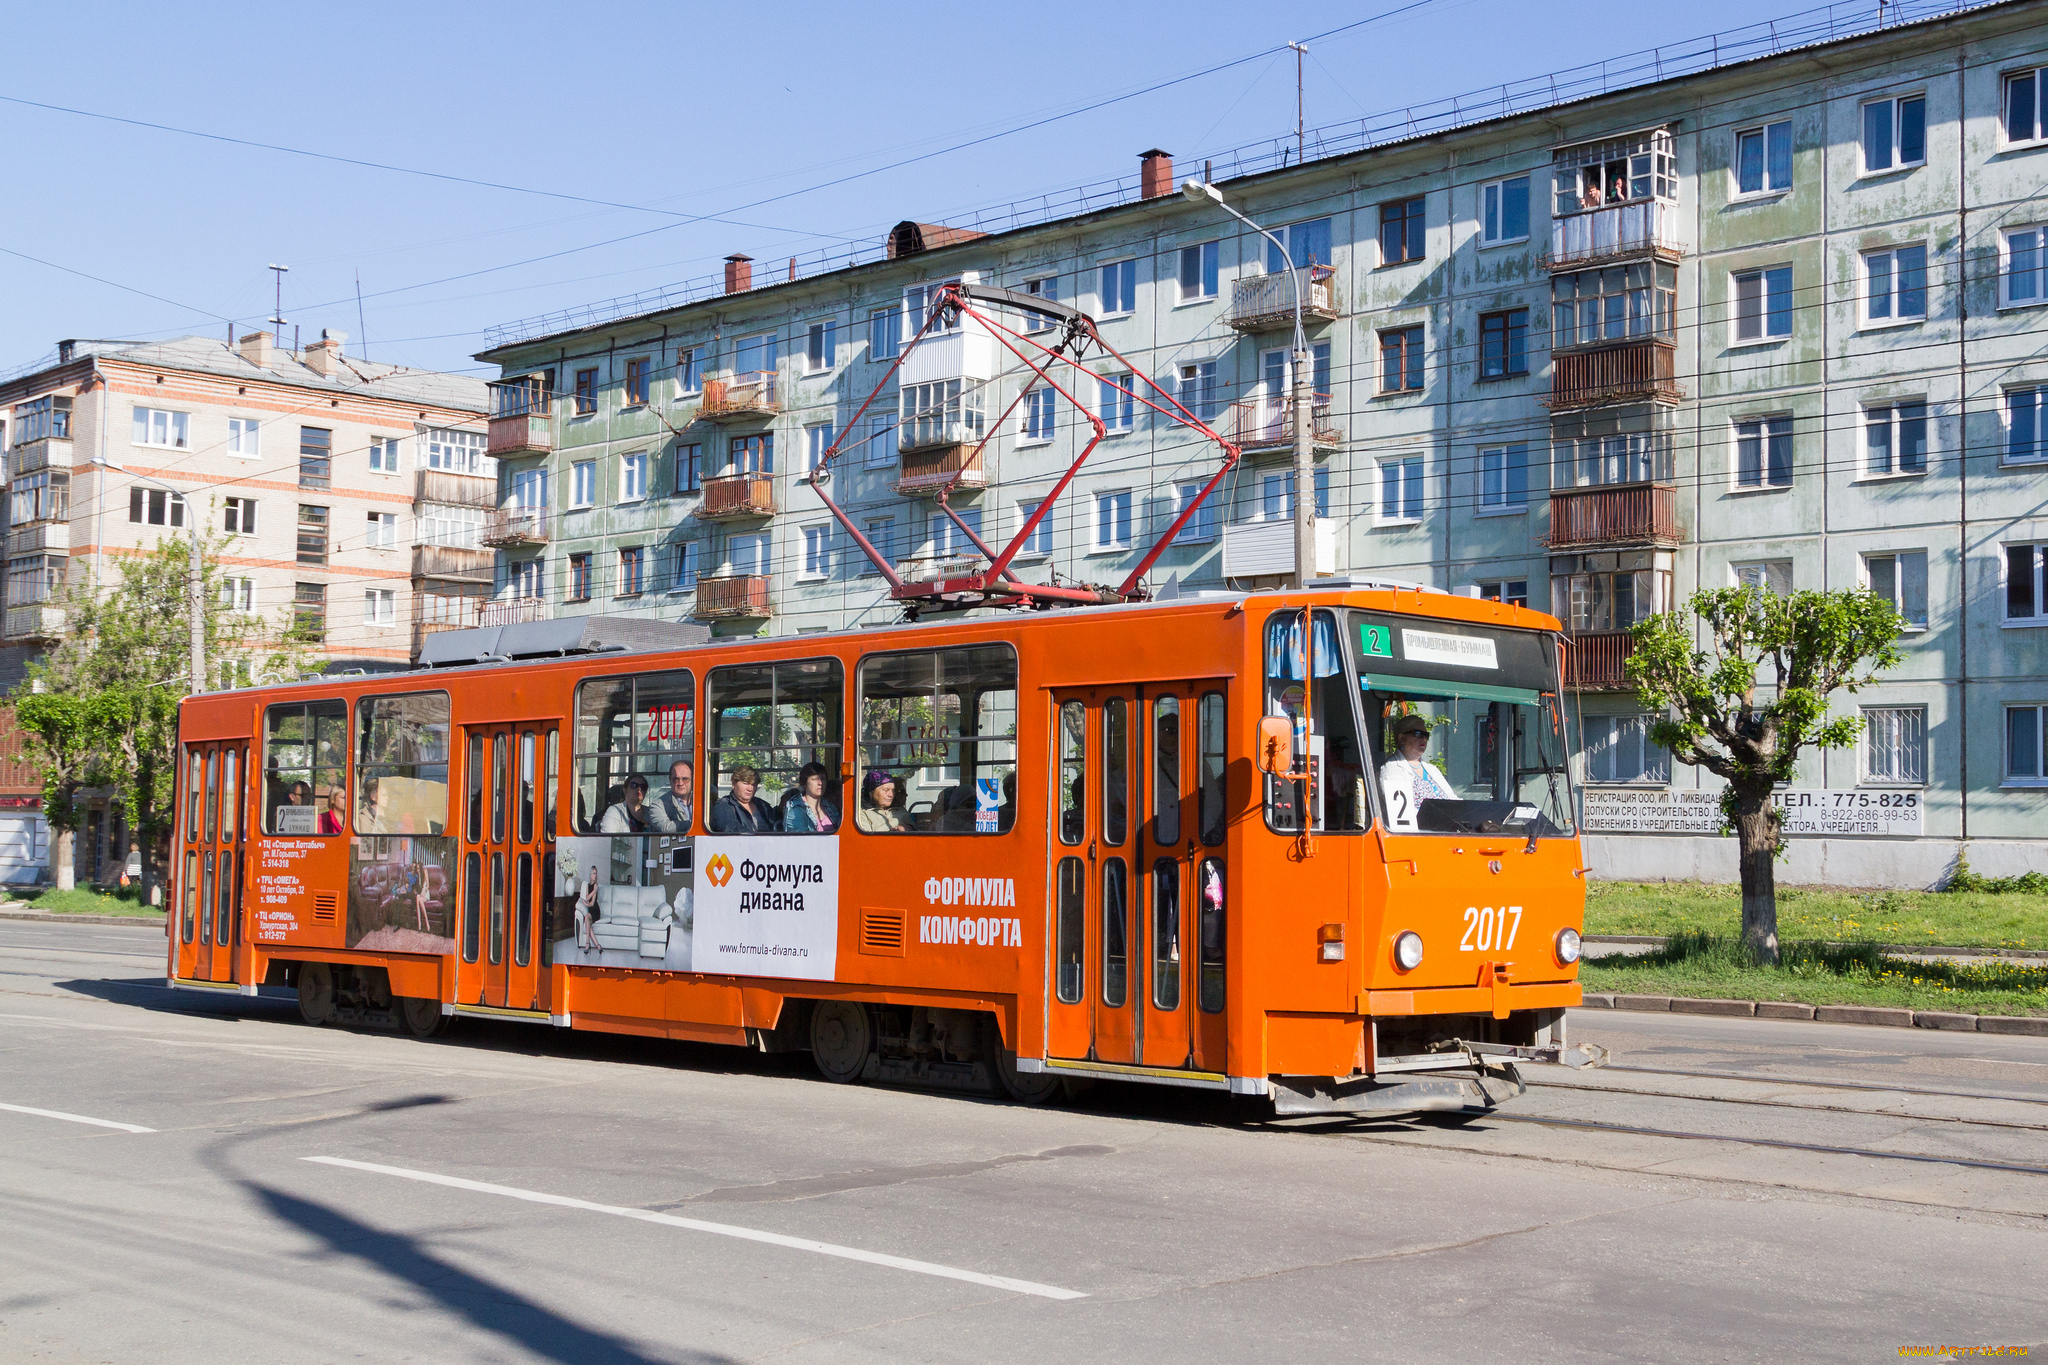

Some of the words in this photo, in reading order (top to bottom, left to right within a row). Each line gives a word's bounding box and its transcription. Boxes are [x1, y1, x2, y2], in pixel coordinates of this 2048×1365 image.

[1369, 629, 1381, 652] 2
[648, 703, 688, 741] 2017
[1585, 792, 1636, 804] РЕГИСТРАЦИЯ
[1638, 793, 1656, 804] ООО,
[1659, 793, 1669, 803] ИП
[1680, 793, 1721, 805] ЛИКВИДАЦ
[1771, 793, 1825, 807] ТЕЛ.:
[1833, 793, 1917, 807] 775-825
[1393, 790, 1410, 825] 2
[1585, 806, 1619, 816] ДОПУСКИ
[1622, 806, 1637, 816] СРО
[1640, 806, 1712, 819] (СТРОИТЕЛЬСТВО,
[1820, 808, 1917, 821] 8-922-686-99-53
[279, 809, 286, 831] 2
[976, 821, 984, 832] 70
[985, 821, 998, 832] ЛЕТ
[1585, 819, 1630, 829] ИЗМЕНЕНИЯ
[1633, 820, 1638, 829] В
[1640, 820, 1708, 831] УЧРЕДИТЕЛЬНЫЕ
[1783, 821, 1819, 832] ЕКТОРА,
[263, 839, 272, 850] ТЦ
[268, 858, 289, 868] 514-318
[261, 875, 273, 885] ТРЦ
[273, 875, 300, 885] «ОМЕГА»
[740, 858, 824, 889] Формула
[924, 876, 1016, 907] ФОРМУЛА
[740, 892, 805, 913] дивана
[259, 910, 268, 921] ТЦ
[264, 930, 286, 940] 912-572
[920, 915, 1022, 947] КОМФОРТА
[1460, 906, 1523, 951] 2017
[719, 943, 808, 957] www.formula-divana.ru
